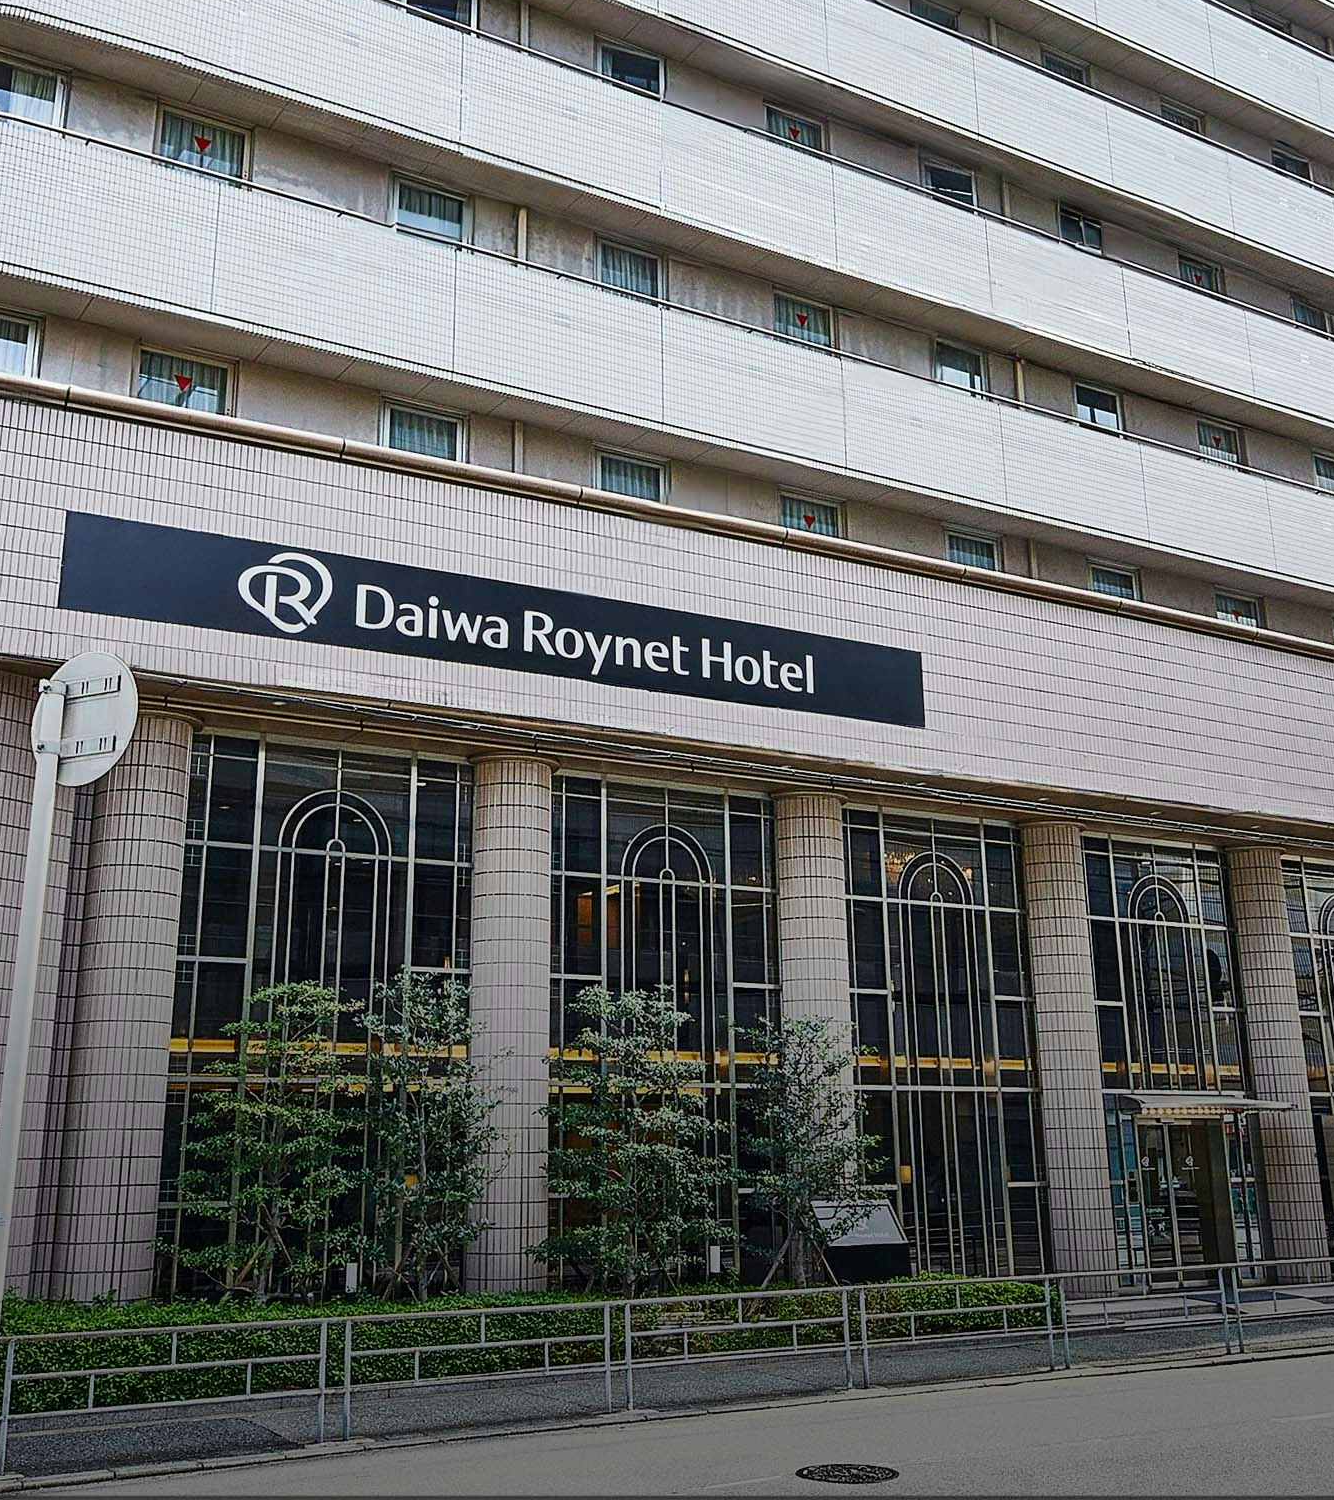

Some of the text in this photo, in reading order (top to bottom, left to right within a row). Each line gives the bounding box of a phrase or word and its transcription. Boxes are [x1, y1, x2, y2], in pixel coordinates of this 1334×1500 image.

[354, 583, 509, 649] Daiwa
[522, 609, 690, 676] Roynet
[700, 637, 815, 694] Hotel
